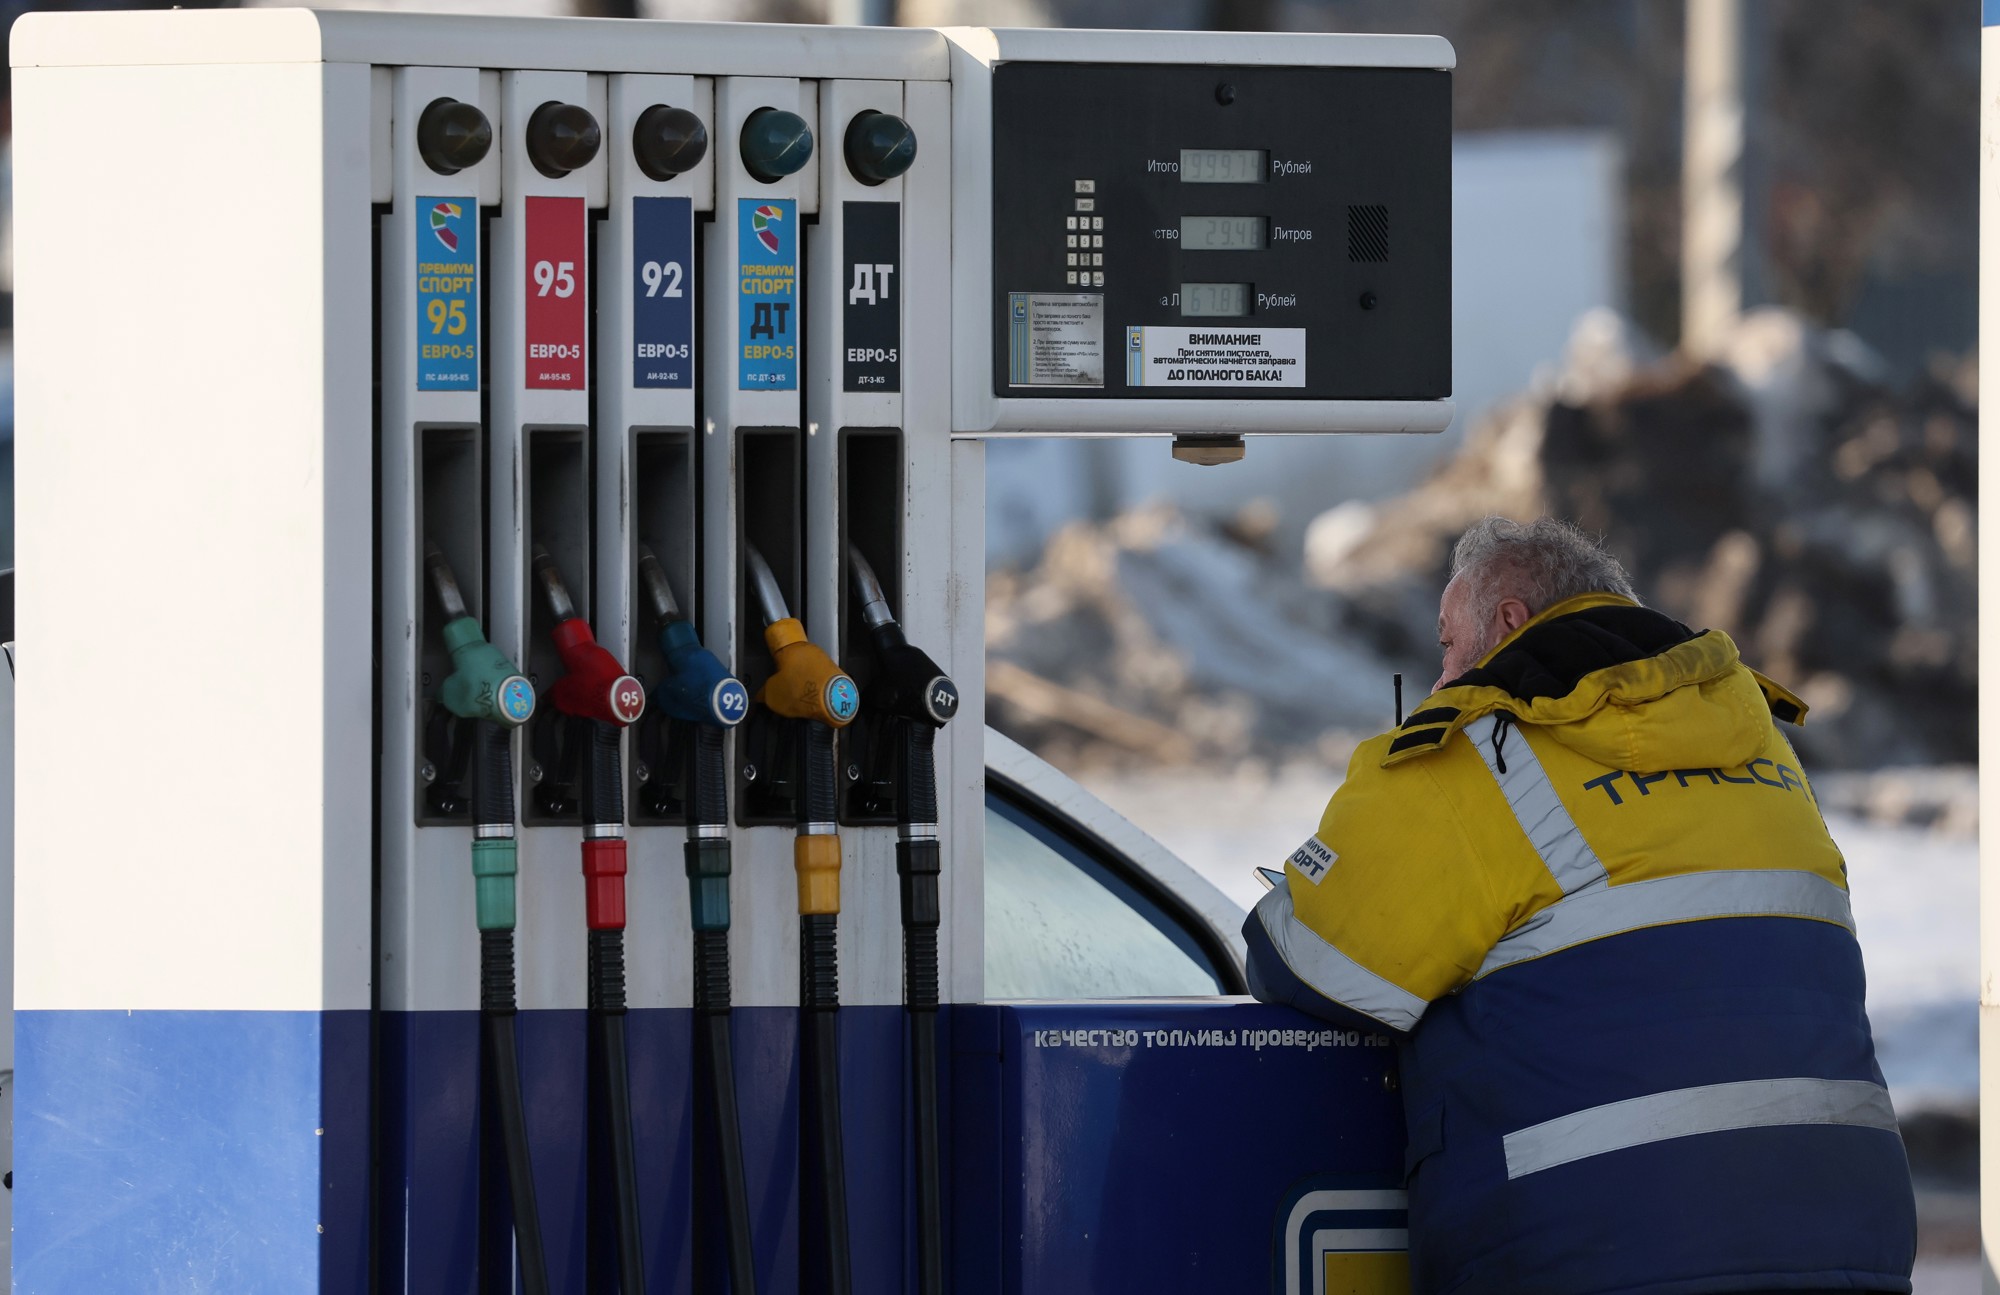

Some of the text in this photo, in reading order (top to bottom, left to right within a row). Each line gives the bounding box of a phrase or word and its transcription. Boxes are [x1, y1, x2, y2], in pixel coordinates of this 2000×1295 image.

[1147, 159, 1179, 173] Итого
[1273, 160, 1312, 177] Рублей
[1273, 226, 1313, 243] Литров
[418, 263, 474, 275] ПРЕМИУМ
[741, 264, 794, 276] ПРЕМИУМ
[418, 276, 474, 293] СПОРТ
[533, 260, 575, 298] 95
[642, 261, 683, 298] 92
[741, 278, 794, 294] СПОРТ
[849, 264, 894, 306] ДТ
[1258, 293, 1296, 310] Рублей
[427, 299, 467, 336] 95
[750, 302, 790, 340] ДТ
[1189, 334, 1261, 345] ВНИМАНИЕ!
[422, 345, 474, 359] ЕВРО-5
[530, 344, 580, 358] ЕВРО-5
[638, 344, 688, 358] ЕВРО-5
[744, 346, 794, 359] ЕВРО-5
[848, 348, 897, 362] ЕВРО-5
[1178, 348, 1194, 358] При
[1226, 350, 1272, 358] пистолета,
[1153, 356, 1218, 365] автоматически
[1258, 358, 1296, 366] заправка
[425, 373, 436, 382] ПС
[539, 373, 571, 381] АИ-95-К5
[647, 372, 678, 380] АИ-92-К5
[747, 374, 758, 382] ПС
[1167, 370, 1282, 381] ДО ПОЛНОГО БАКА!
[621, 690, 639, 706] 95
[722, 694, 744, 712] 92
[935, 690, 955, 707] ДТ
[514, 701, 528, 714] 95
[840, 701, 852, 714] ДТ
[1034, 1029, 1138, 1048] качество
[1143, 1029, 1236, 1048] топлива
[1241, 1028, 1360, 1051] проверено
